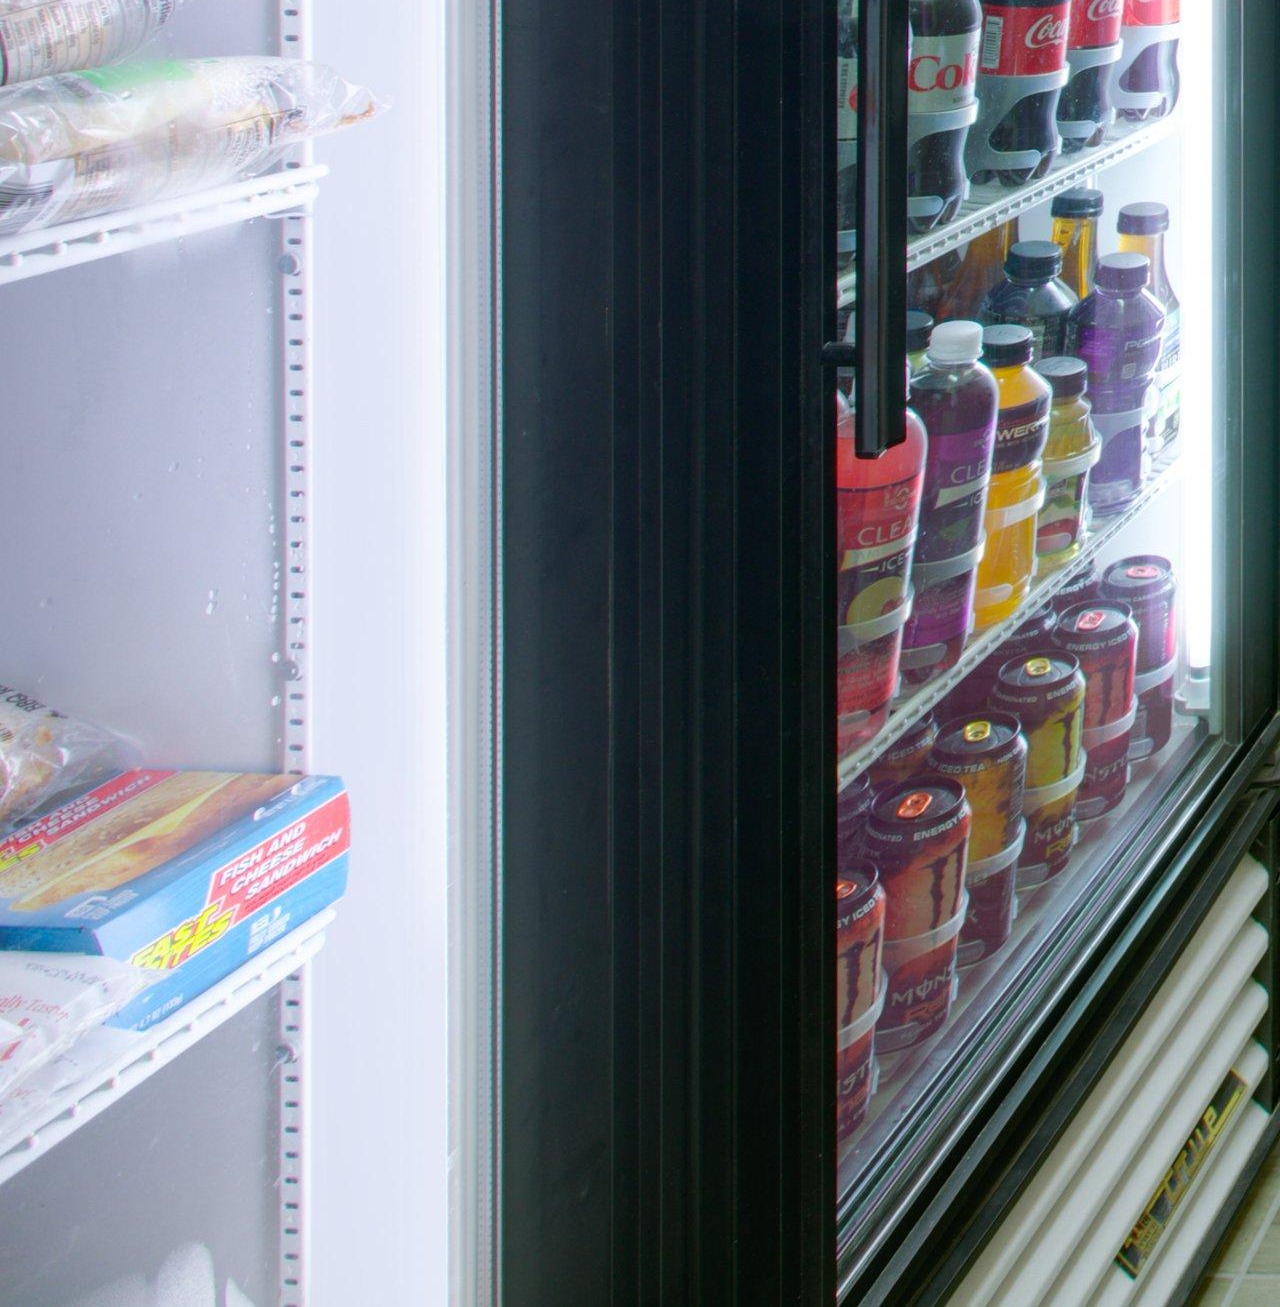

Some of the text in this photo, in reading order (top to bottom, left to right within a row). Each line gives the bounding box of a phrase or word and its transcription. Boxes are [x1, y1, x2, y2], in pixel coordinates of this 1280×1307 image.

[219, 822, 307, 887] FISH AND
[230, 835, 308, 894] CHEESE
[245, 827, 343, 901] SANDWICH
